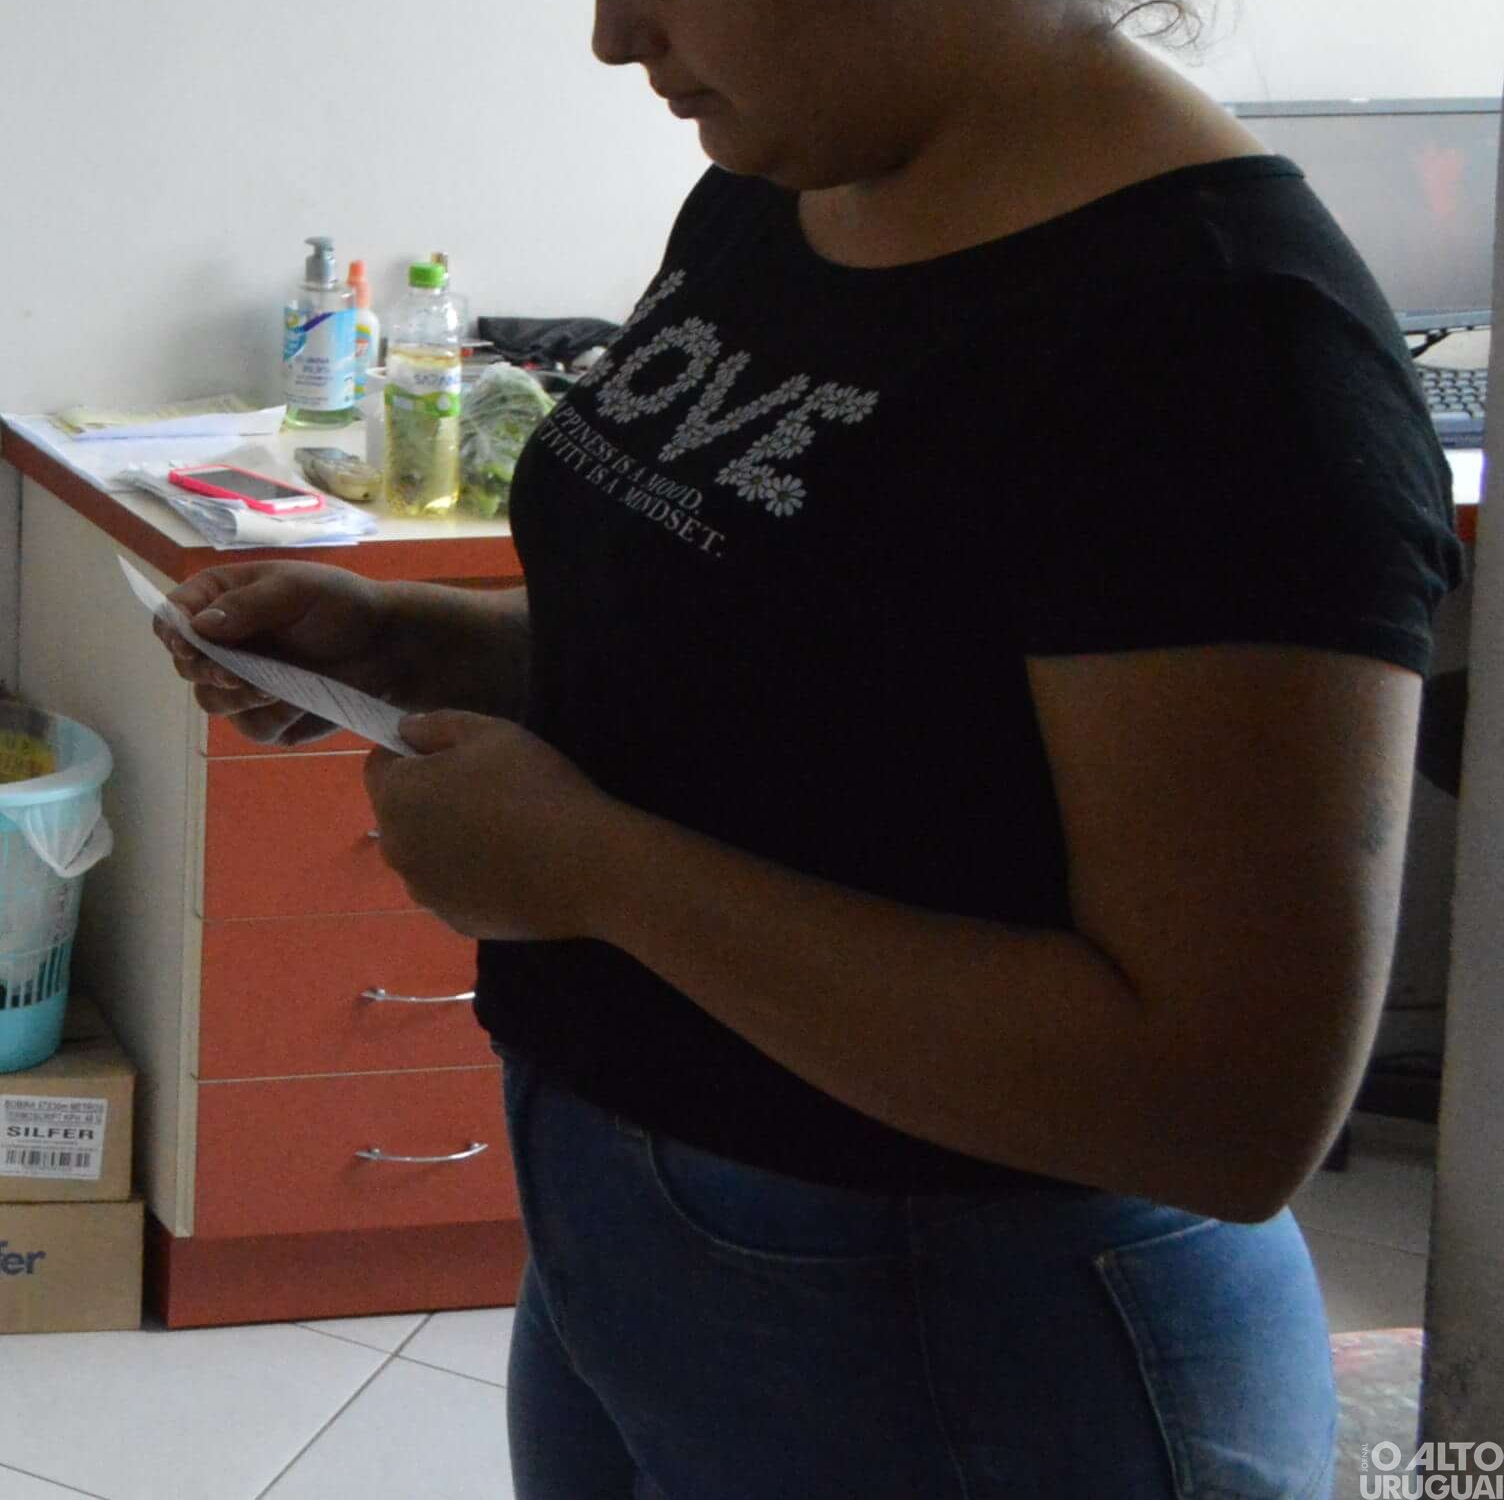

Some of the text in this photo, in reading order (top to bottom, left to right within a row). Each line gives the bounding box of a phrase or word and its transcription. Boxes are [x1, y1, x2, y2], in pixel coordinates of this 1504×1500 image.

[555, 400, 618, 463] PPINESS
[612, 454, 636, 474] IS
[627, 467, 648, 483] A
[585, 463, 609, 485] IS
[603, 477, 620, 494] A
[619, 486, 726, 558] MINDSET.
[5, 1125, 95, 1141] SILFER
